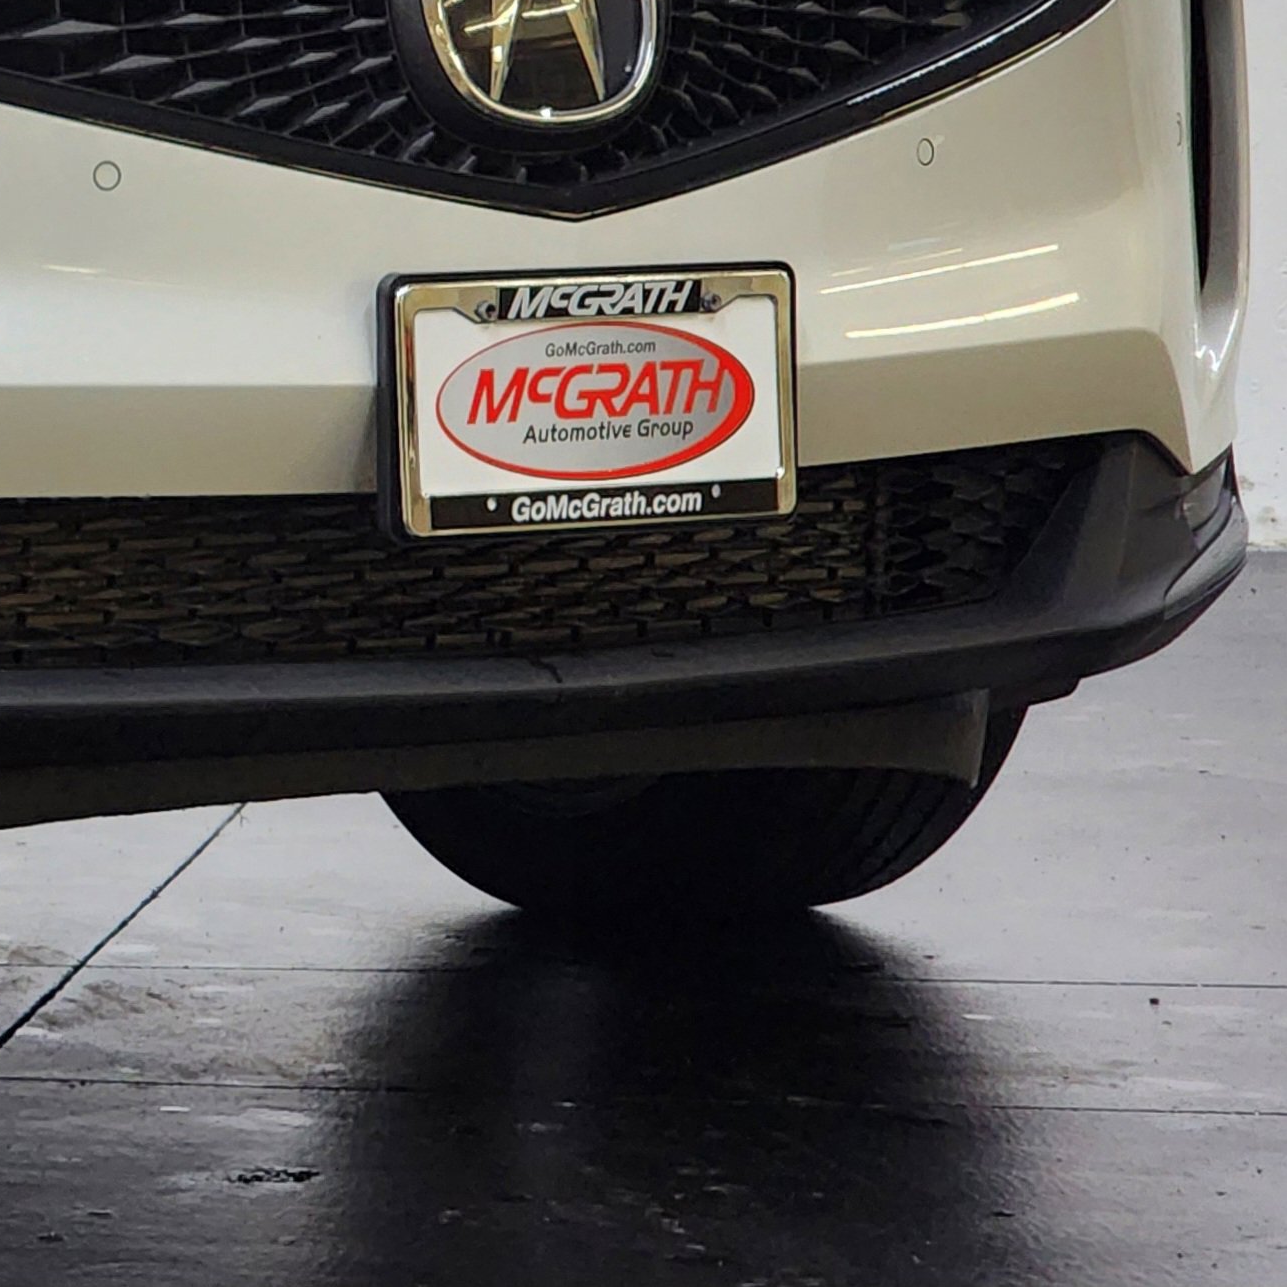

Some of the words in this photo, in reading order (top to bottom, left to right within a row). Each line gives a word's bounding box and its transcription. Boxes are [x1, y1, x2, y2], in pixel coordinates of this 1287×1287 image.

[544, 341, 657, 358] GoMcGrath.com
[523, 420, 632, 444] Automotive
[637, 417, 694, 441] Group
[511, 489, 703, 523] GoMcGrath.com
